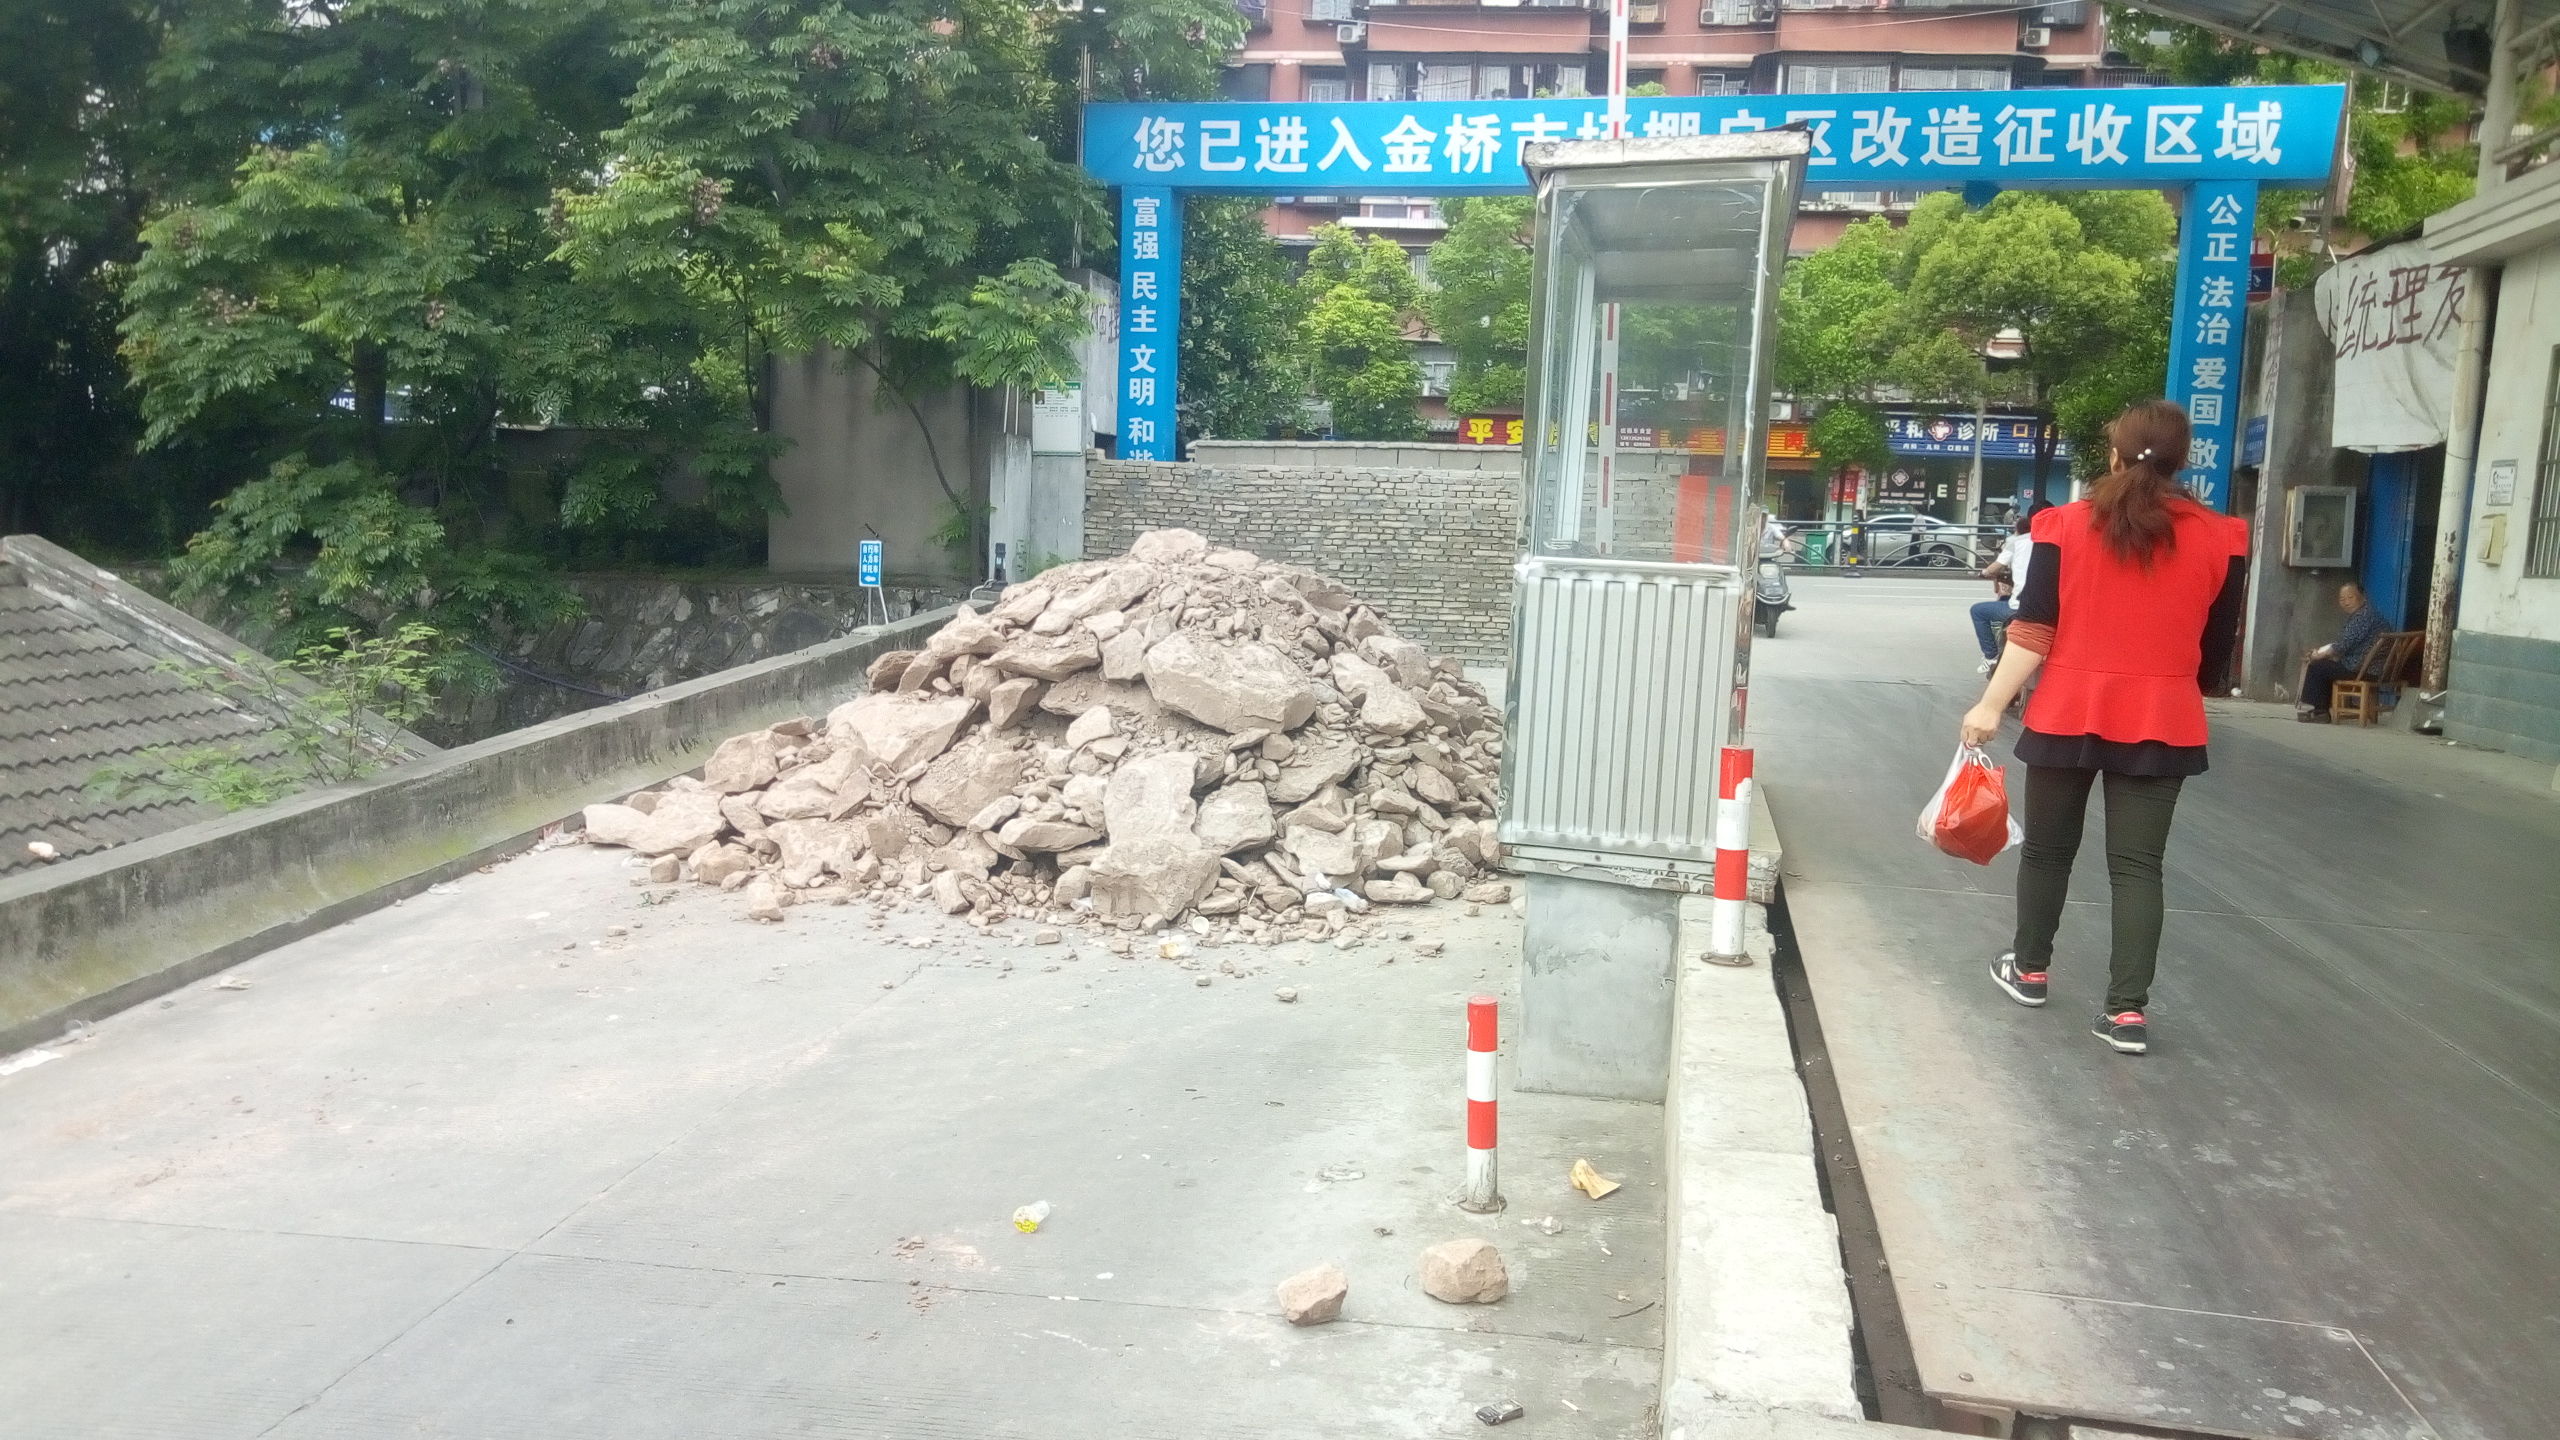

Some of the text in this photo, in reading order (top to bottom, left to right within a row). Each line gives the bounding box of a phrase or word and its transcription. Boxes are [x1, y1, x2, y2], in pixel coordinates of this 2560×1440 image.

[1132, 196, 1160, 260] 富强
[2202, 194, 2242, 262] 公正
[1130, 271, 1158, 333] 民主
[2195, 276, 2234, 346] 法治
[1129, 343, 1156, 406] 文明
[2189, 357, 2227, 426] 爱国
[1957, 422, 2000, 442] 诊所
